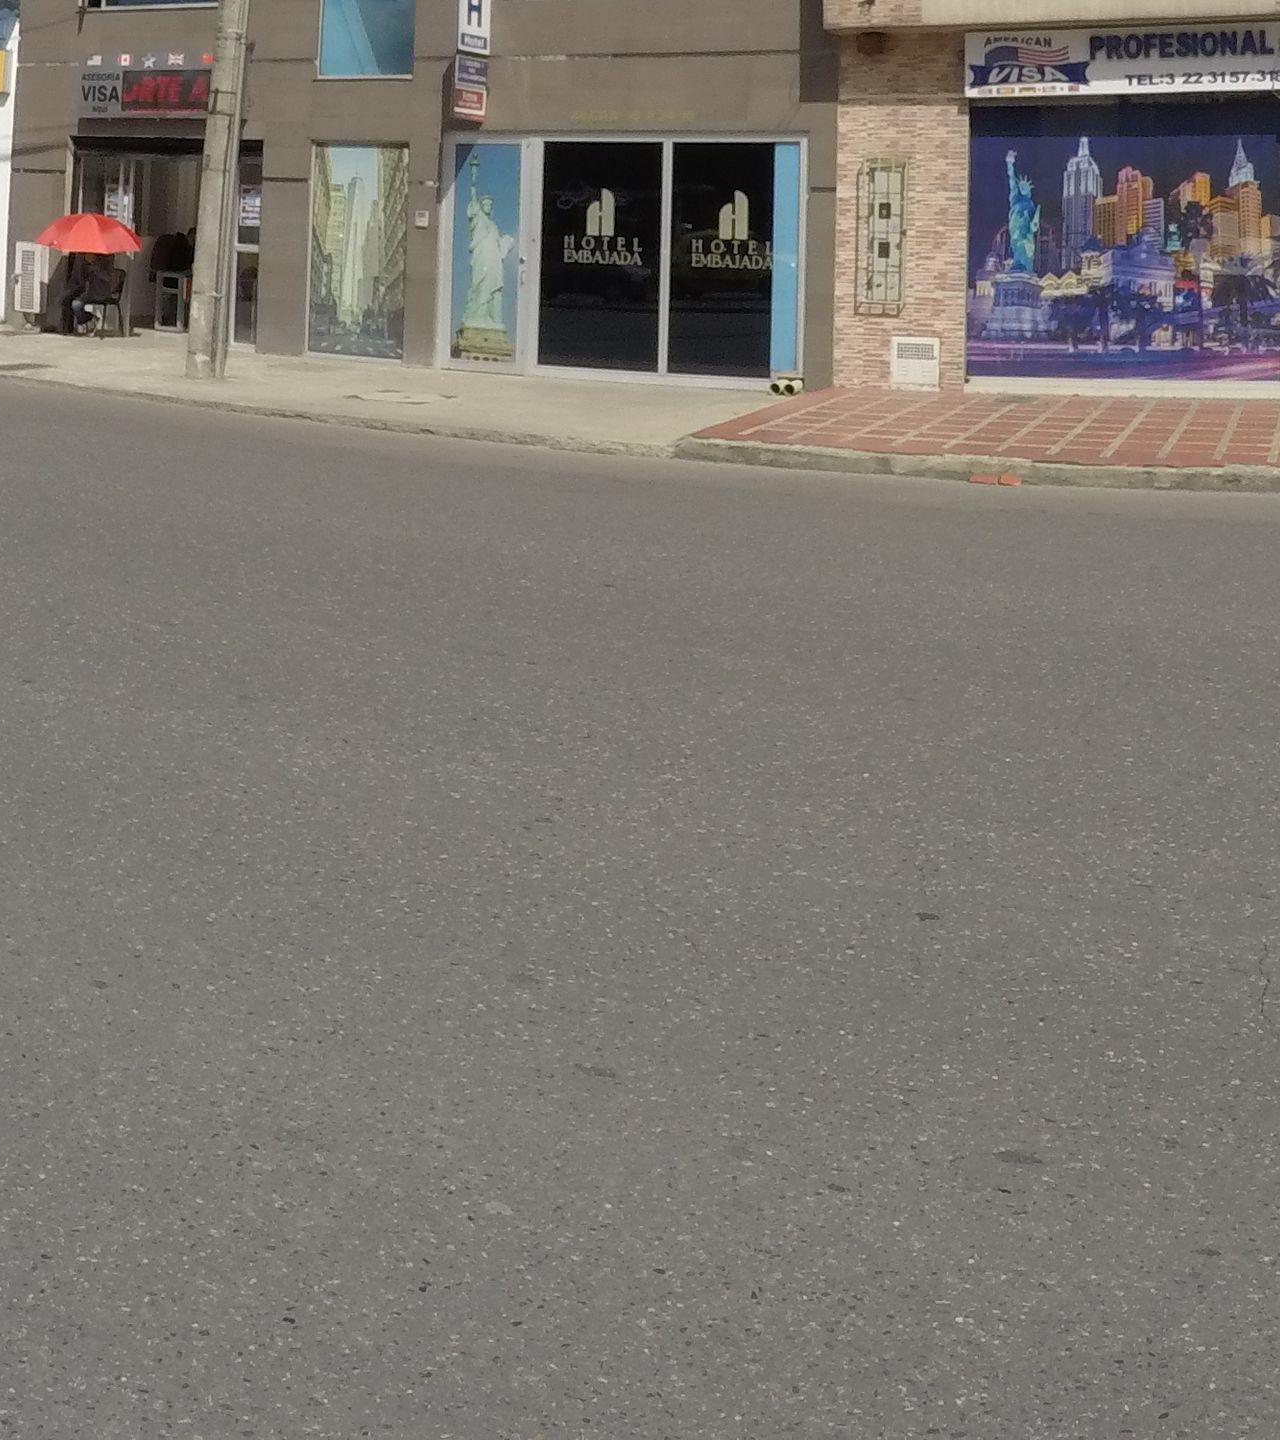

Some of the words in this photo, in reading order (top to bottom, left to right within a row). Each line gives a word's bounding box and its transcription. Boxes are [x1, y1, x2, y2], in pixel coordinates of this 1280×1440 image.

[1089, 29, 1275, 60] PROFESIONAL
[81, 73, 120, 81] ASESORIA
[987, 65, 1071, 83] VISA
[81, 85, 120, 102] VISA
[563, 235, 643, 252] HOTEL
[563, 249, 643, 266] EMBAJADA
[691, 253, 773, 270] EMBAJADA
